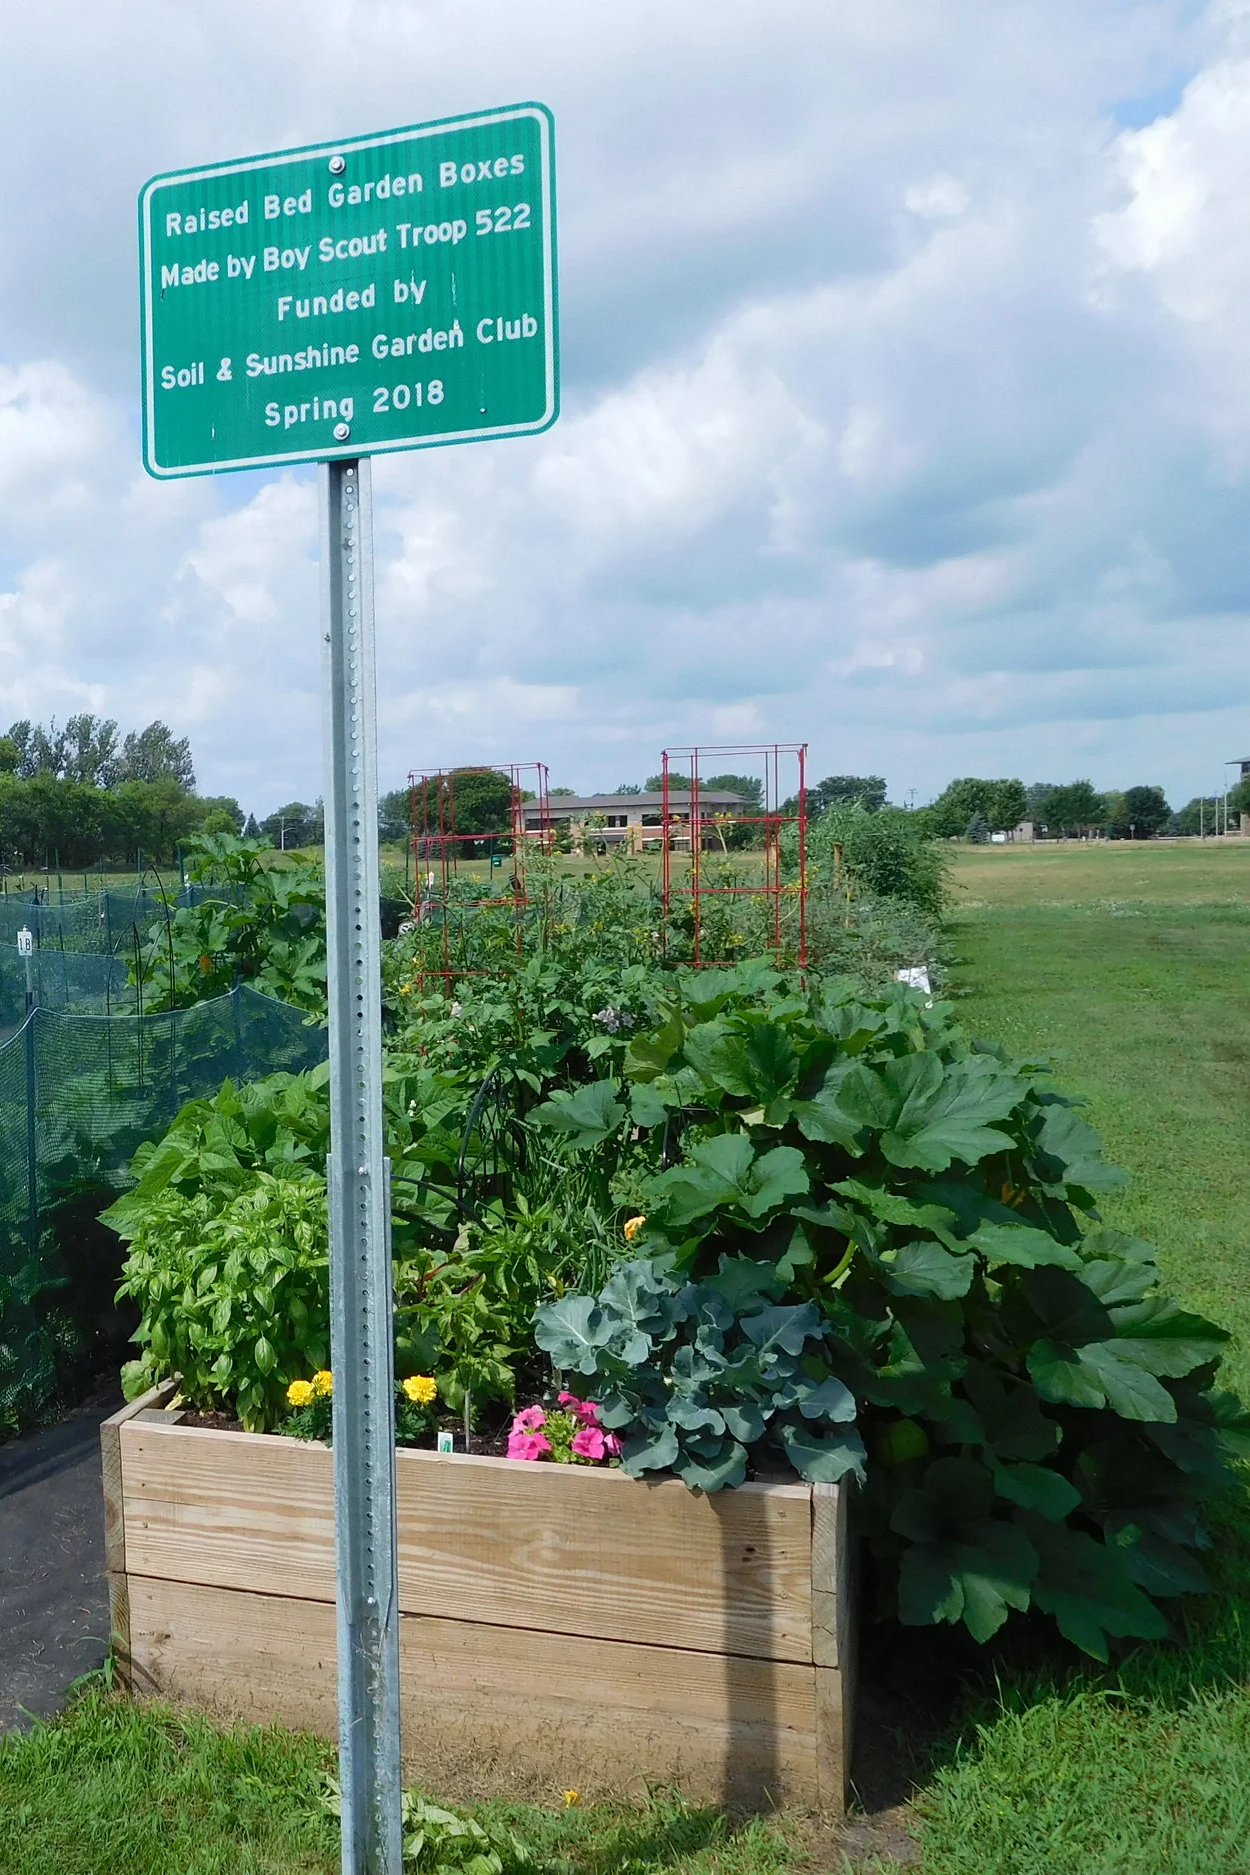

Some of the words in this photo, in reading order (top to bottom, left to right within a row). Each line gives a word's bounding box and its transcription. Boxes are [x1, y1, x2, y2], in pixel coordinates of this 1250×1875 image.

[166, 200, 249, 237] Raised
[264, 188, 312, 220] Bed
[328, 171, 423, 209] Garden
[439, 153, 525, 188] Boxes
[161, 258, 219, 289] Made
[227, 253, 256, 280] by
[263, 245, 311, 272] Boy
[318, 228, 387, 262] Scout
[396, 218, 467, 248] Troop
[475, 203, 531, 236] 522
[277, 282, 376, 321] Funded
[394, 278, 427, 304] by
[161, 361, 204, 390] Soil
[216, 357, 233, 382] &
[245, 342, 360, 377] Sunshine
[372, 325, 464, 359] Garden
[476, 313, 538, 344] Club
[264, 396, 354, 430] Spring
[372, 379, 445, 413] 2018
